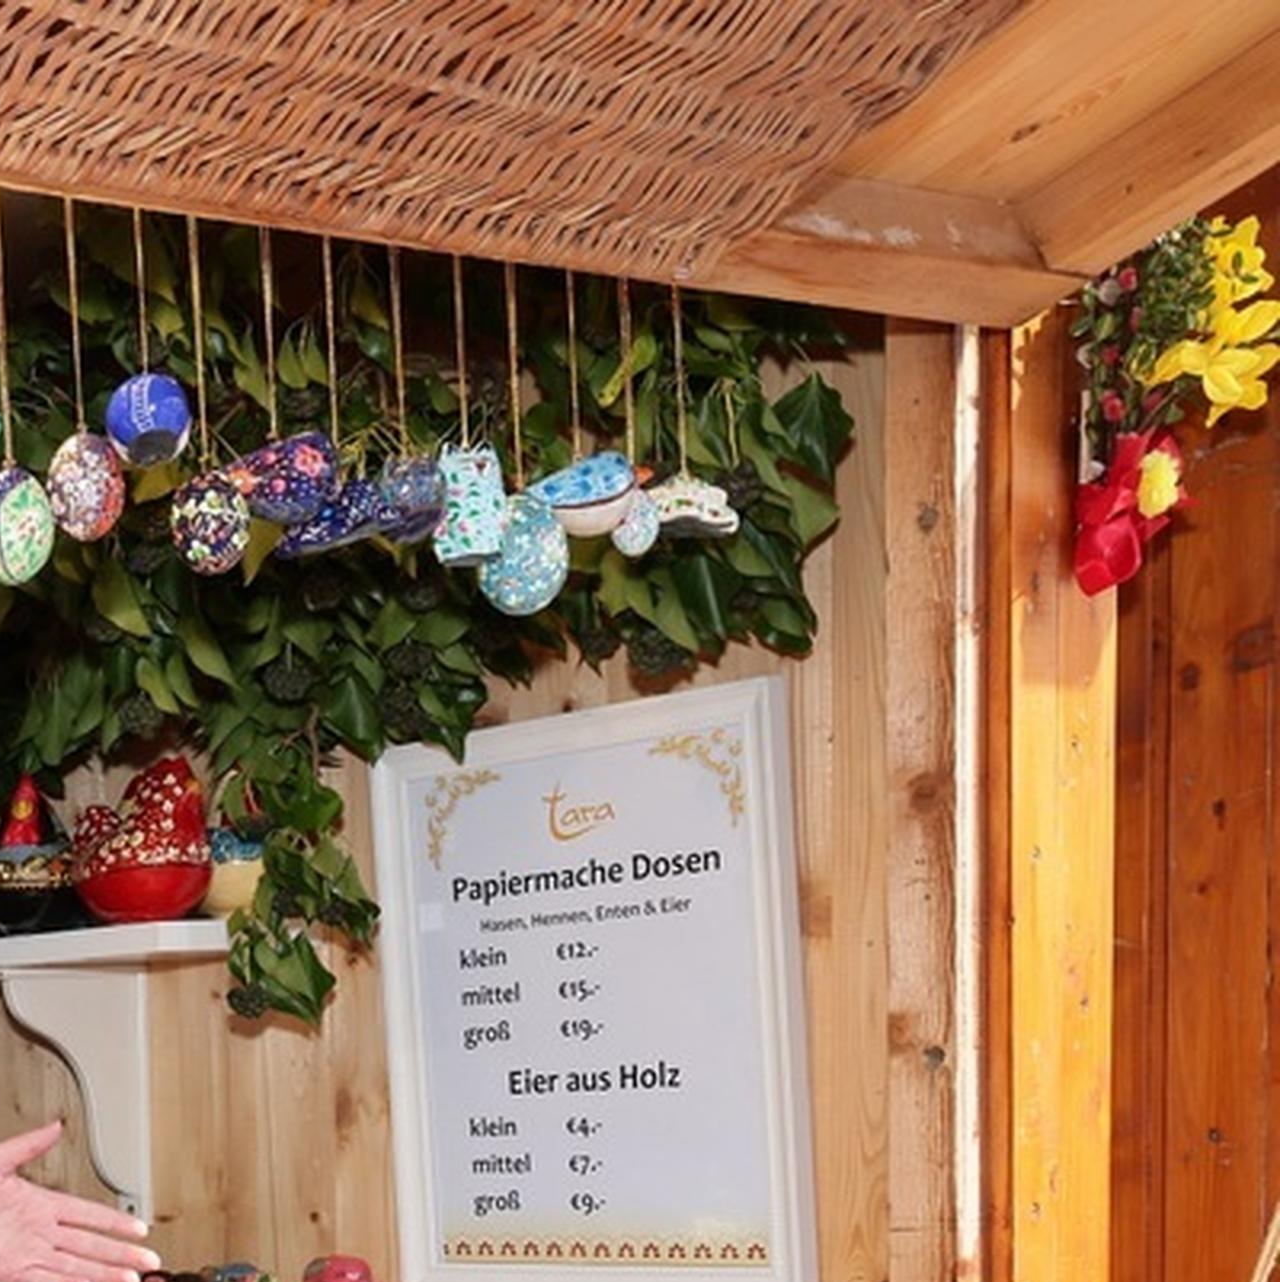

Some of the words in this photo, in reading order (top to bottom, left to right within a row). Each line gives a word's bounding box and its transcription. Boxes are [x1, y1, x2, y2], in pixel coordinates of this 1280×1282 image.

[541, 781, 616, 842] tara
[451, 858, 626, 904] Papiermache
[631, 846, 722, 881] Dosen
[479, 914, 528, 933] Hasen,
[530, 907, 594, 930] Hennen,
[595, 900, 642, 922] Enten
[643, 899, 658, 917] &
[660, 895, 692, 915] Eier
[459, 946, 508, 970] klein
[555, 940, 600, 961] €12.-
[461, 981, 521, 1006] mittel
[558, 978, 601, 1001] €15.-
[463, 1019, 511, 1050] groß
[559, 1018, 604, 1042] €19.-
[507, 1067, 560, 1096] Eier
[565, 1070, 612, 1093] aus
[618, 1060, 681, 1090] Holz
[469, 1115, 518, 1139] klein
[565, 1117, 603, 1138] €4.-
[472, 1152, 532, 1175] mittel
[568, 1154, 603, 1177] €7.-
[473, 1189, 521, 1217] groß
[569, 1193, 606, 1217] €9.-
